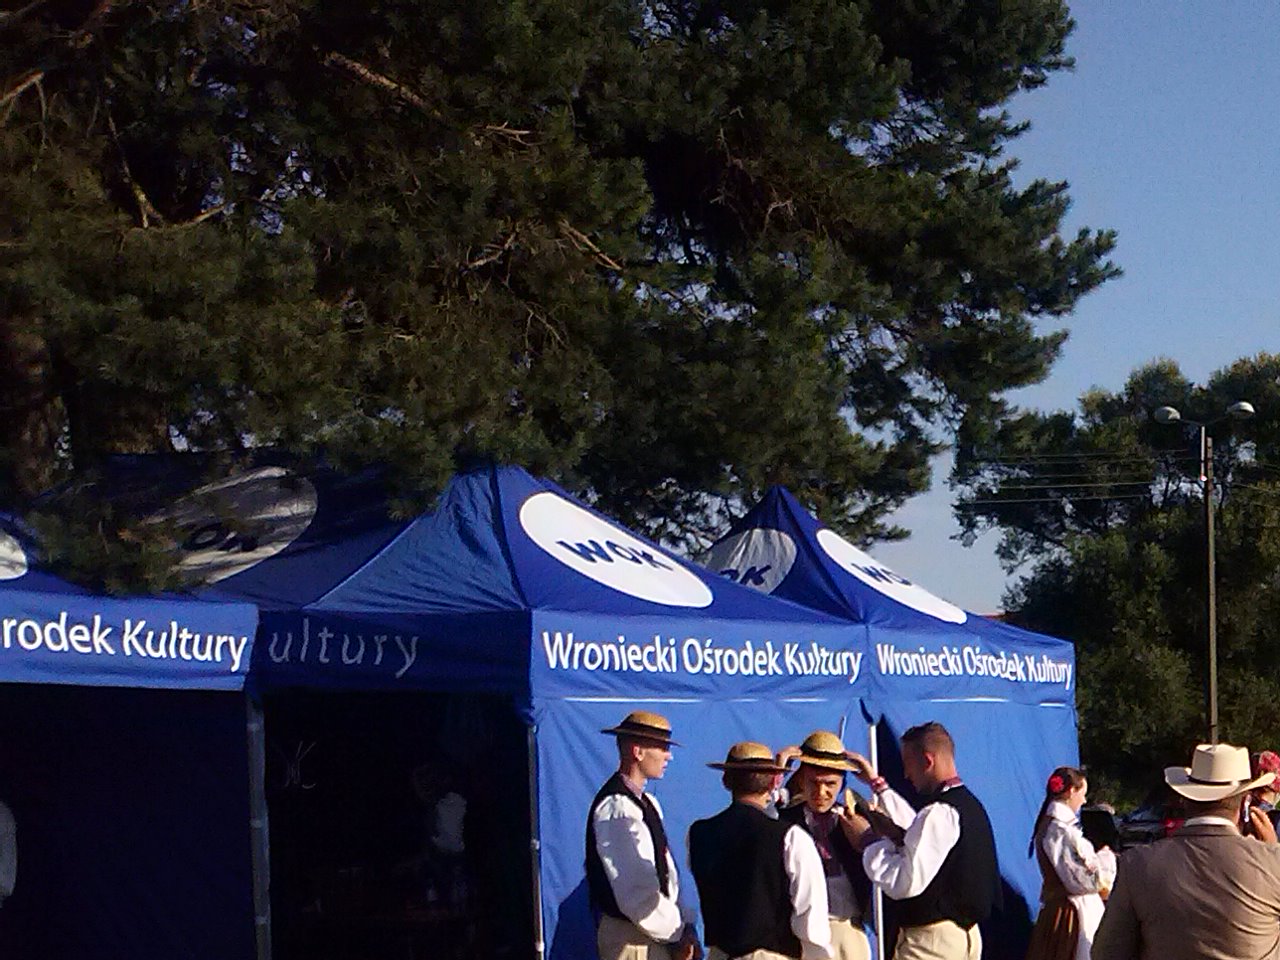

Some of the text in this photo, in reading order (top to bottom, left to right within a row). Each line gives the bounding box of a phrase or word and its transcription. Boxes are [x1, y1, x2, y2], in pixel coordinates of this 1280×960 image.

[555, 538, 674, 571] WOK
[2, 611, 248, 673] rodek Kultury
[268, 616, 420, 680] ultury
[542, 632, 863, 685] Wroniecki Ośrodek Kultury
[876, 643, 1073, 690] Wroniecki Ośrodek Kultury
